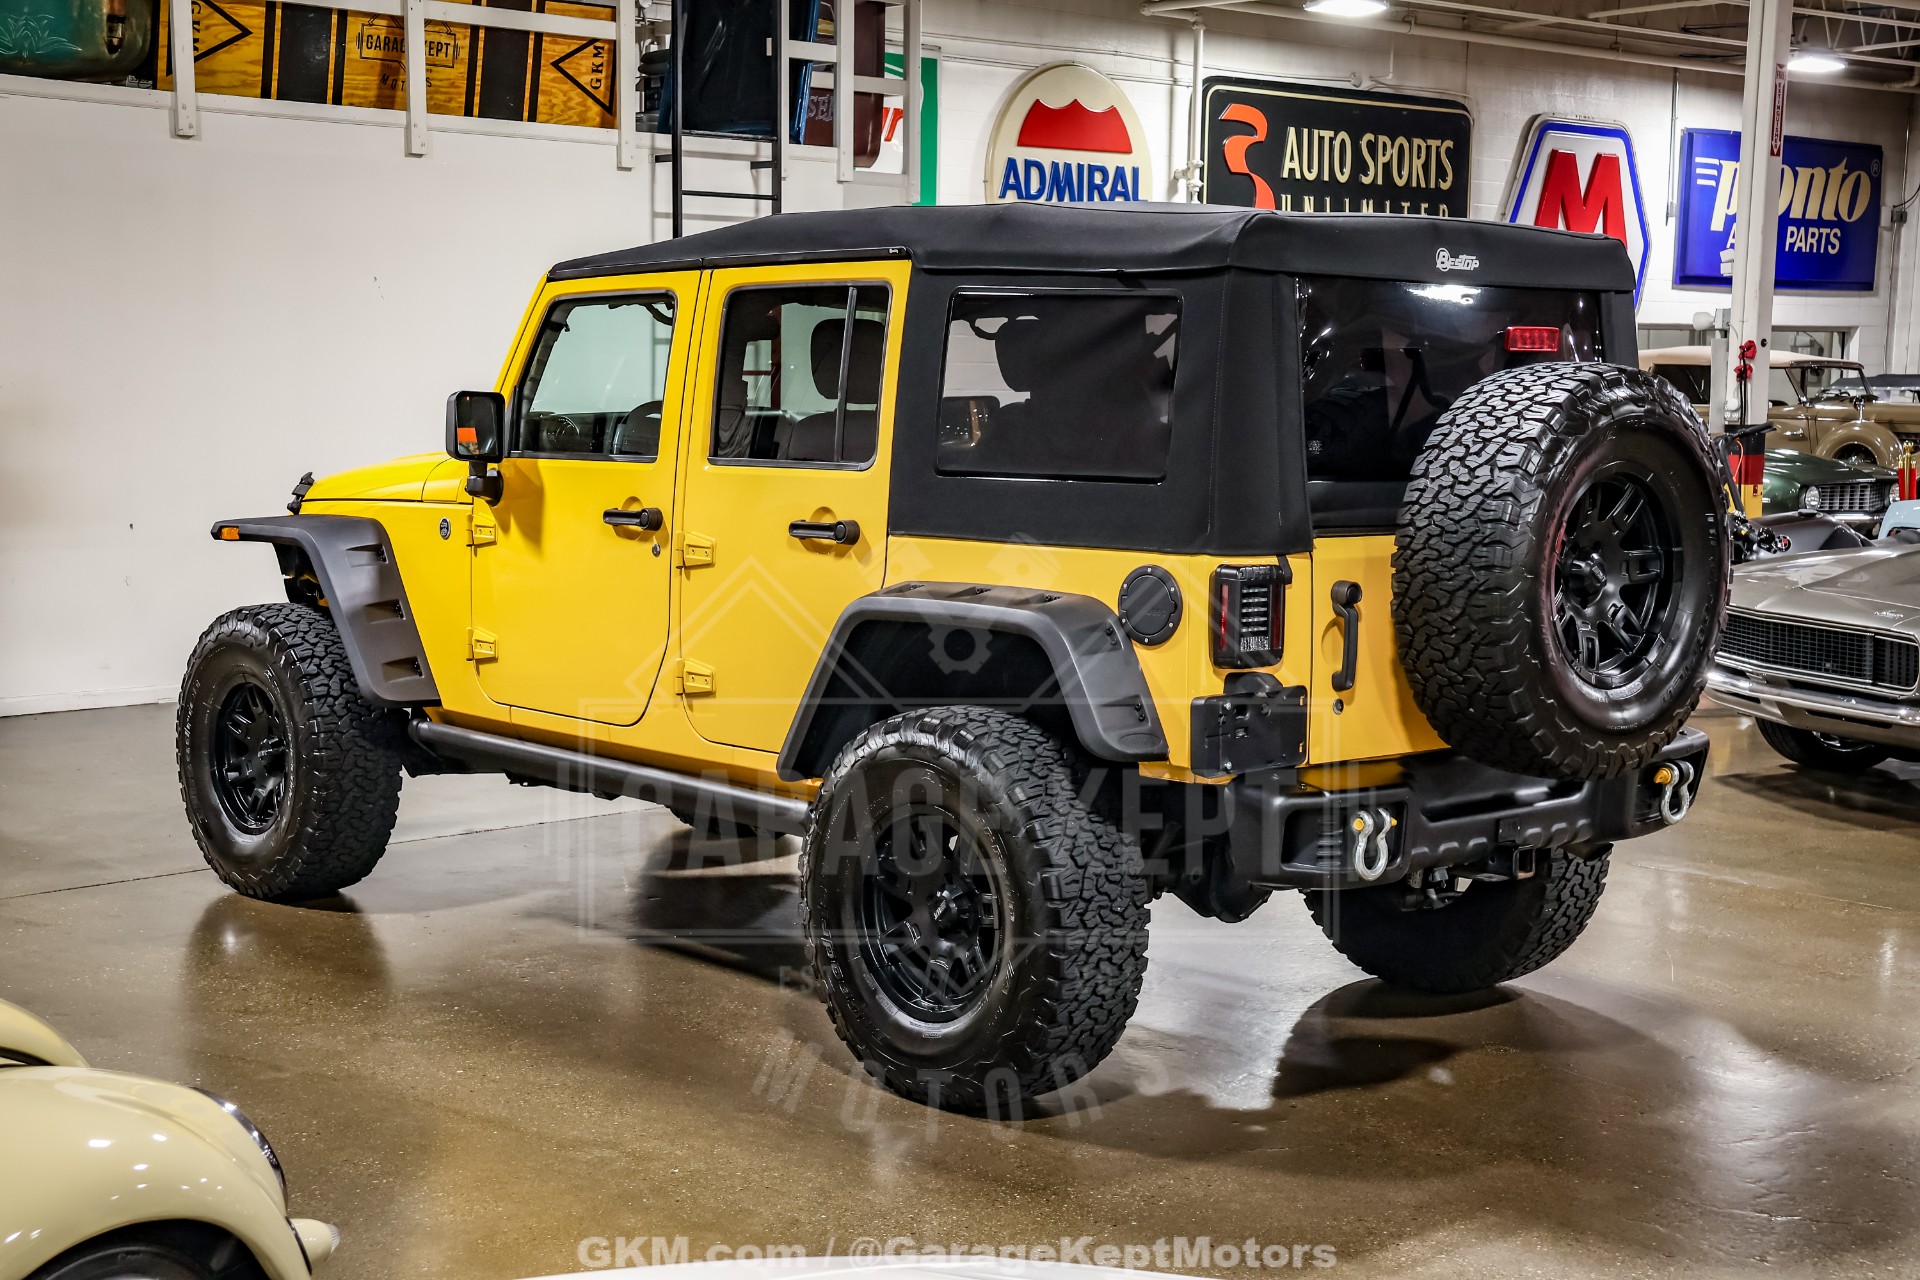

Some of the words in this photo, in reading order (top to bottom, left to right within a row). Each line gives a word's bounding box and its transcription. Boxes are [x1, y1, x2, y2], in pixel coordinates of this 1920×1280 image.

[366, 34, 406, 54] GARAG
[425, 40, 451, 58] EPT
[590, 45, 605, 90] GKM
[381, 73, 432, 92] MOTS
[998, 156, 1149, 202] ADMIRAL
[1280, 126, 1352, 184] AUTO
[1359, 132, 1454, 190] SPORTS
[1534, 149, 1628, 250] M
[1785, 225, 1842, 255] PARTS
